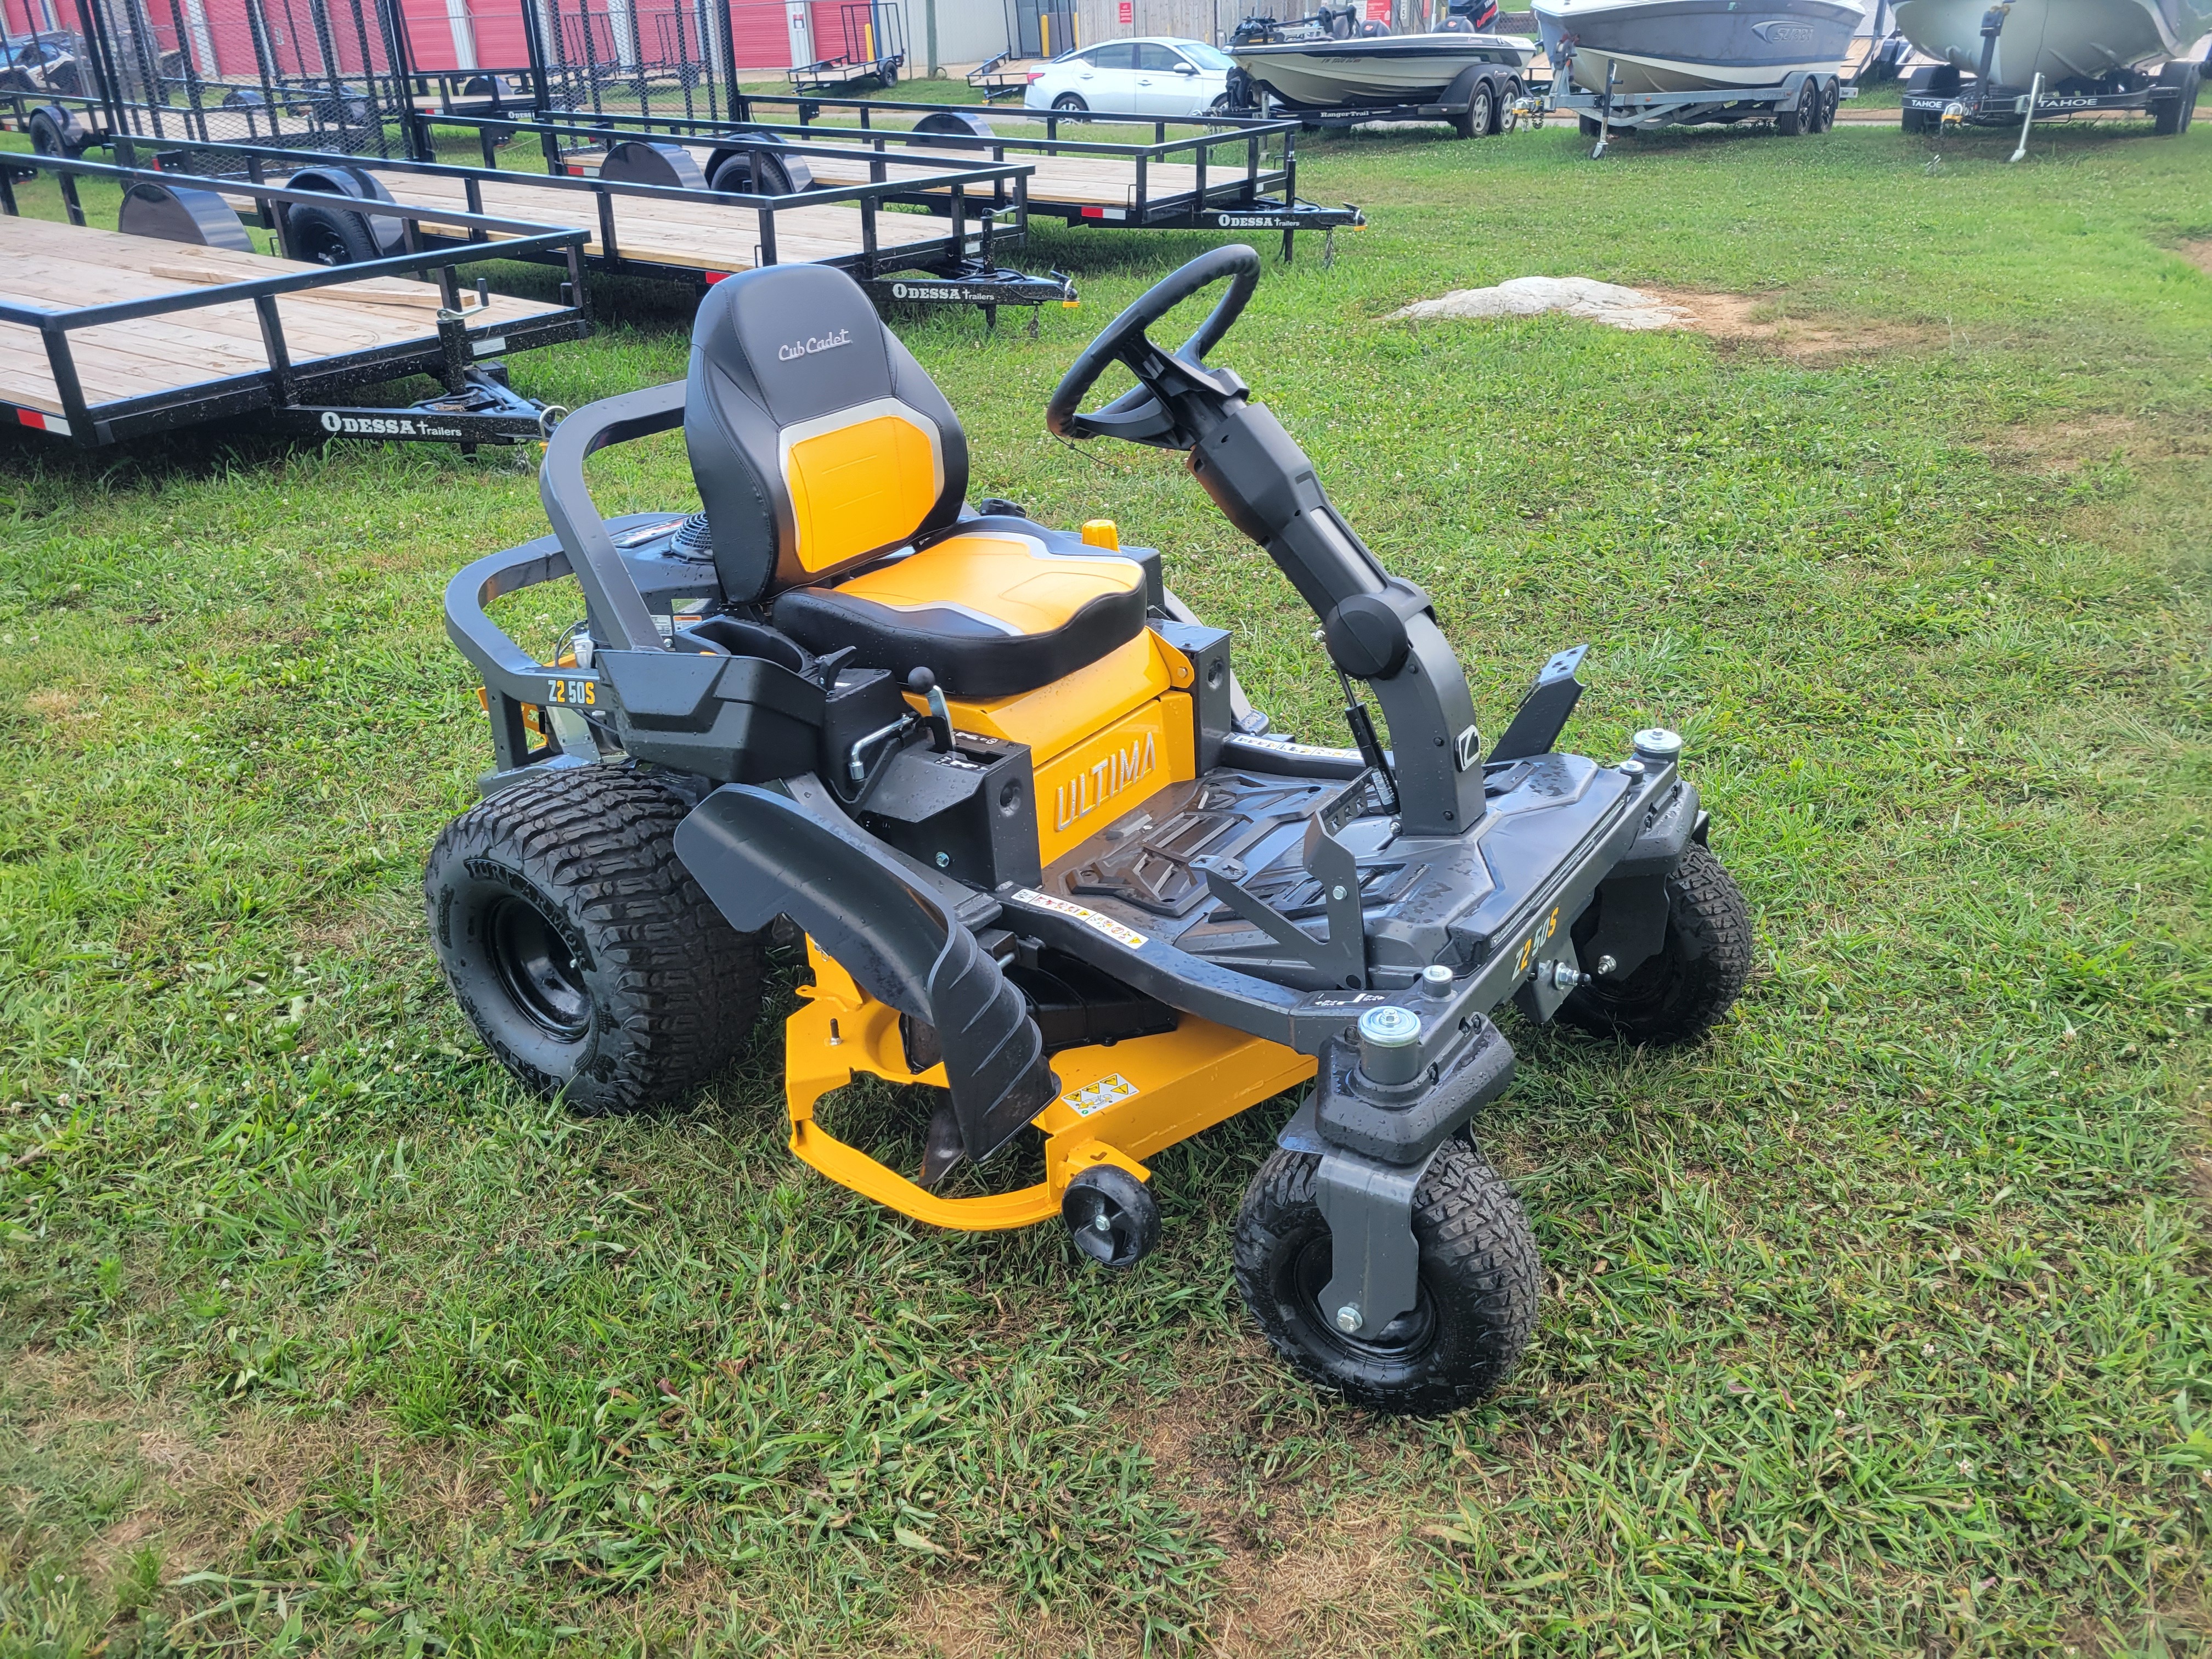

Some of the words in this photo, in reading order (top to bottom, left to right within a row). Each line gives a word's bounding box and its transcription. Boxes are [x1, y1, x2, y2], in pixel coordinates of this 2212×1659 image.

[1911, 100, 1943, 109] TAHOE
[2038, 98, 2098, 108] TAHOE
[1218, 214, 1273, 227] ODESSA
[892, 283, 961, 300] ODESSA
[778, 341, 805, 362] Cub
[805, 329, 851, 354] Cadet
[321, 411, 416, 435] ODESSA
[1055, 731, 1155, 832] ULTIMA
